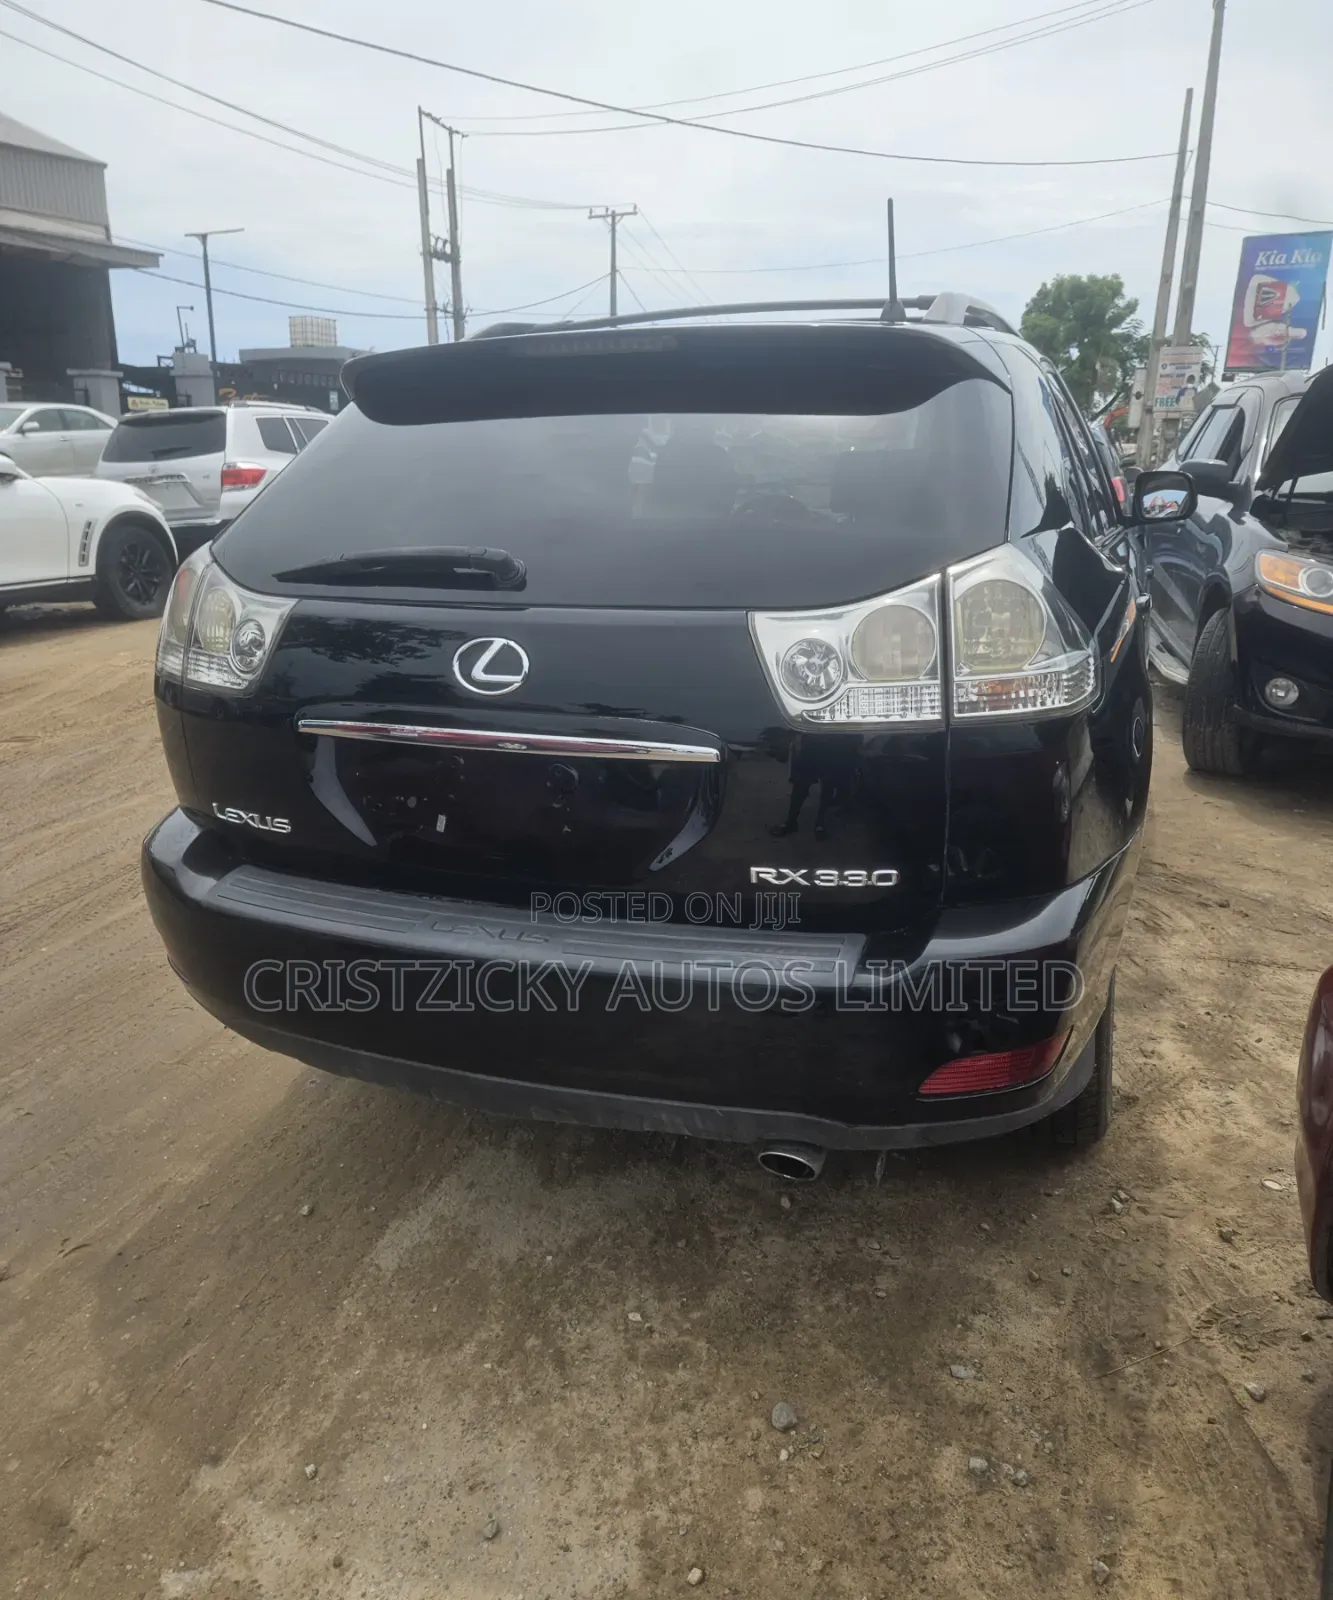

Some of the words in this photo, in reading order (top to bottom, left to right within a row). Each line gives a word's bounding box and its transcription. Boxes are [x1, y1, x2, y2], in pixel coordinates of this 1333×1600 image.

[1255, 250, 1287, 266] Kia
[1290, 248, 1322, 263] Kia
[212, 802, 292, 834] LEXUS
[431, 920, 550, 943] LEXUS
